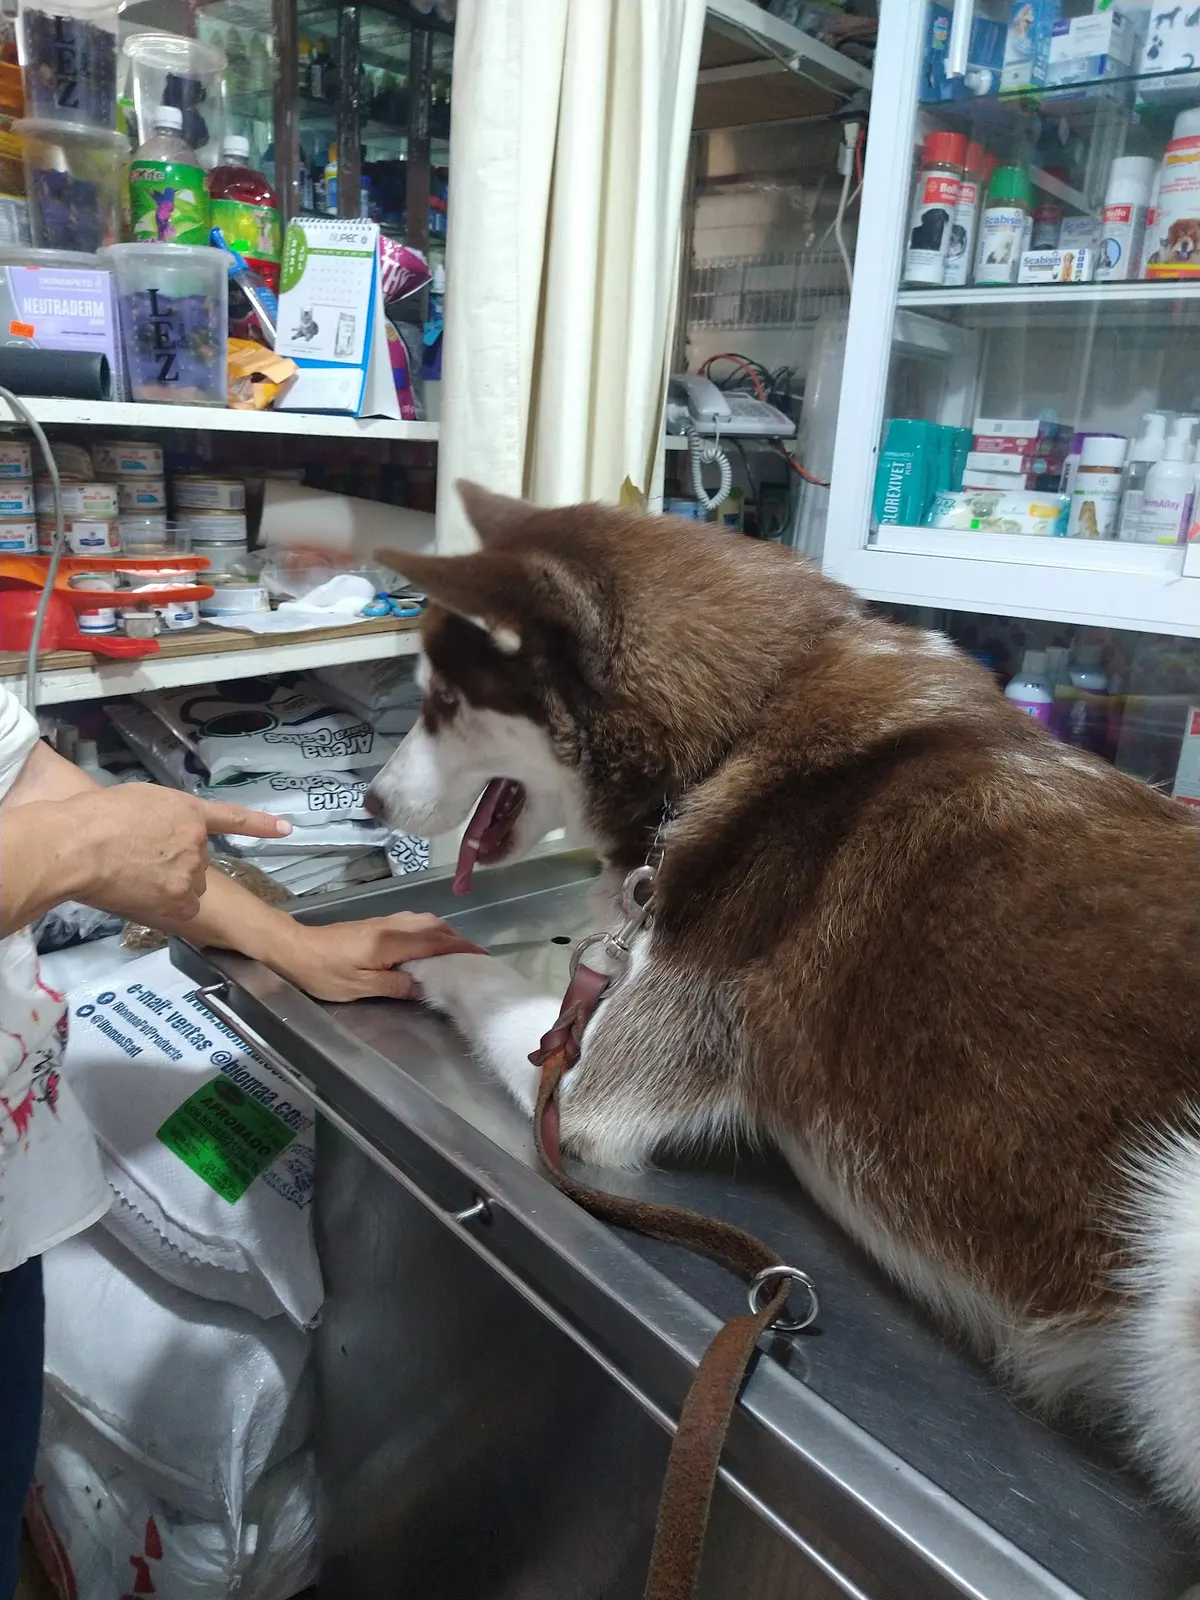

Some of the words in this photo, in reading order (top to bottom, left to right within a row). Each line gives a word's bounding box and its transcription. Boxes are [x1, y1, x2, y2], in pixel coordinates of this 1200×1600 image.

[1023, 255, 1061, 267] Scabisin
[23, 298, 105, 317] NEUTRADERM
[301, 731, 374, 759] Arena
[308, 789, 366, 811] rena
[126, 983, 173, 1016] e-mail:
[164, 1010, 213, 1052] ventas
